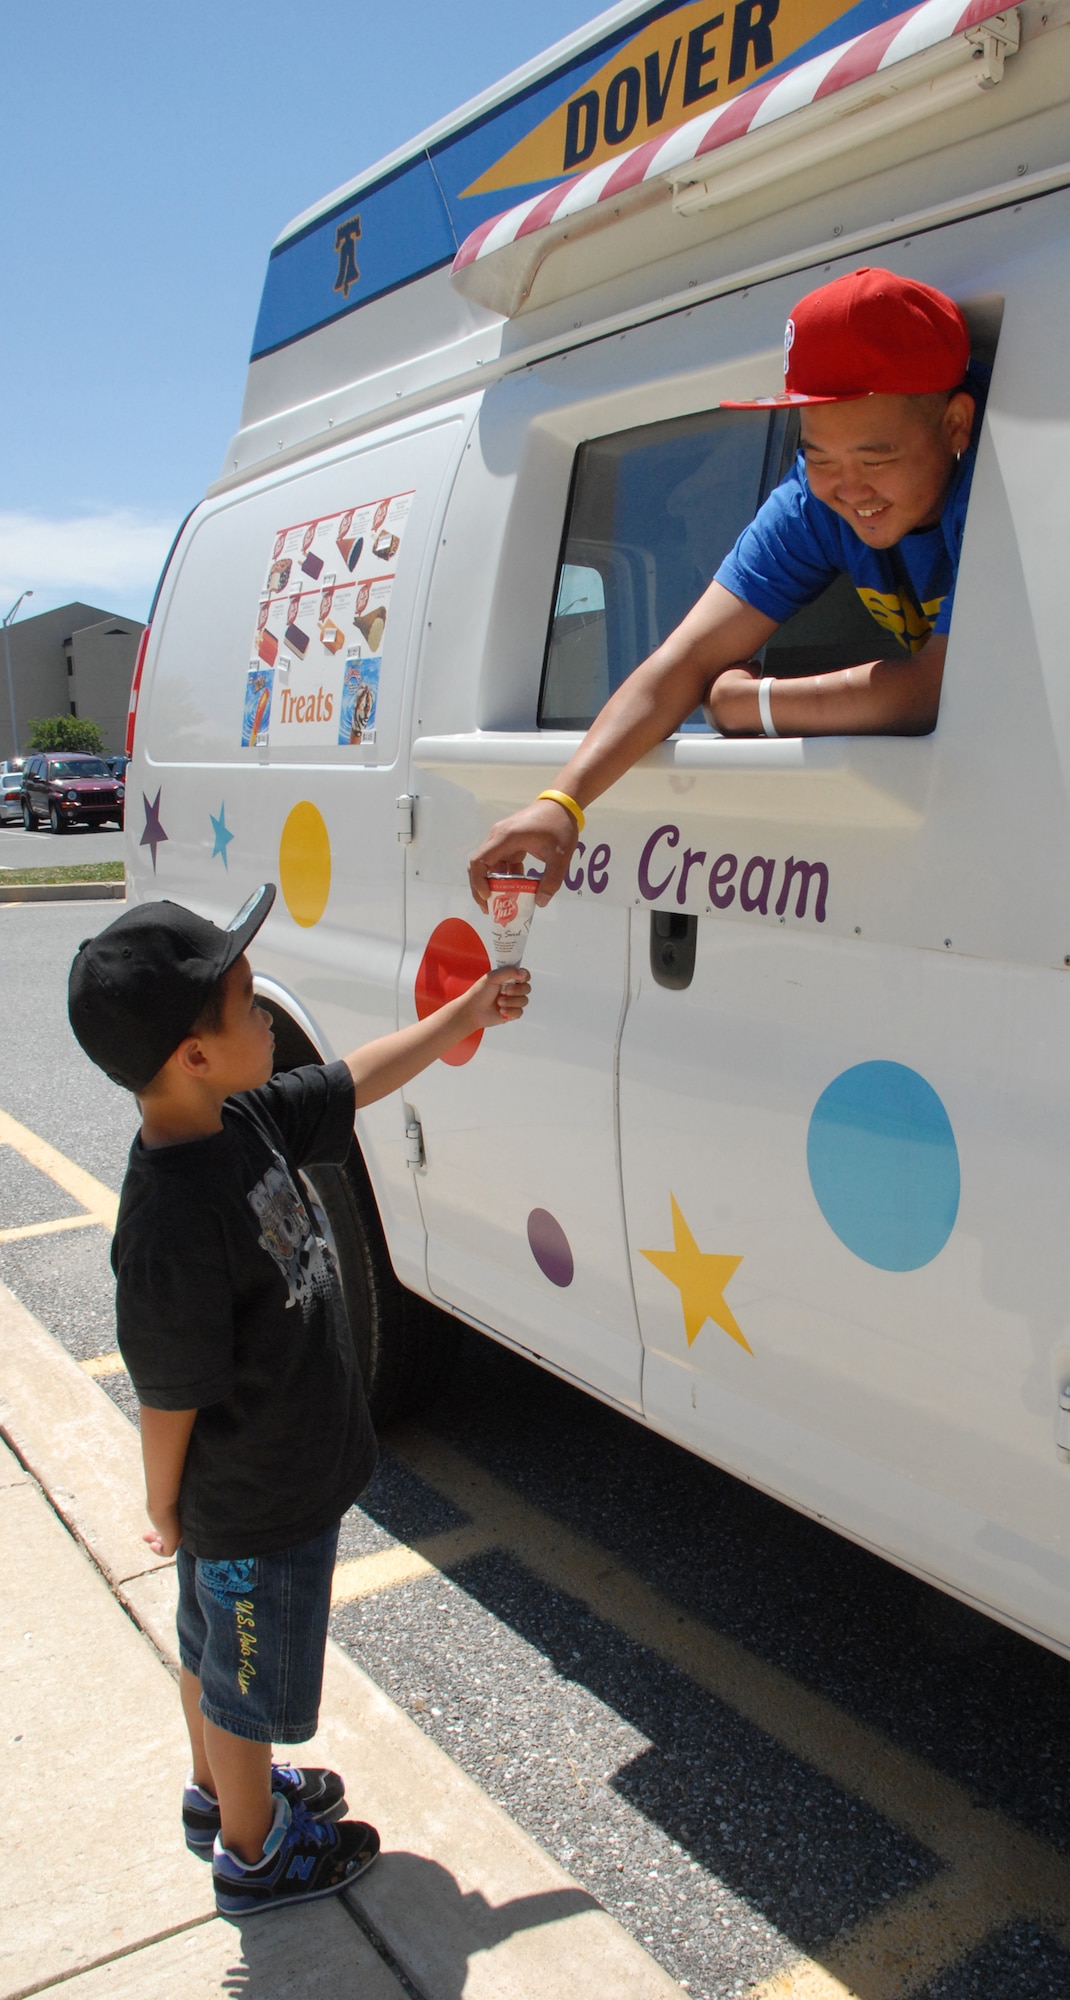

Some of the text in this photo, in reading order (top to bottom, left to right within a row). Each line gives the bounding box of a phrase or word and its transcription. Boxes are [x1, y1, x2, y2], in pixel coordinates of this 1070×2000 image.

[563, 0, 780, 171] DOVER
[280, 685, 333, 723] Treats
[638, 824, 829, 923] Cream
[236, 1630, 258, 1657] Polo
[286, 1855, 317, 1880] N
